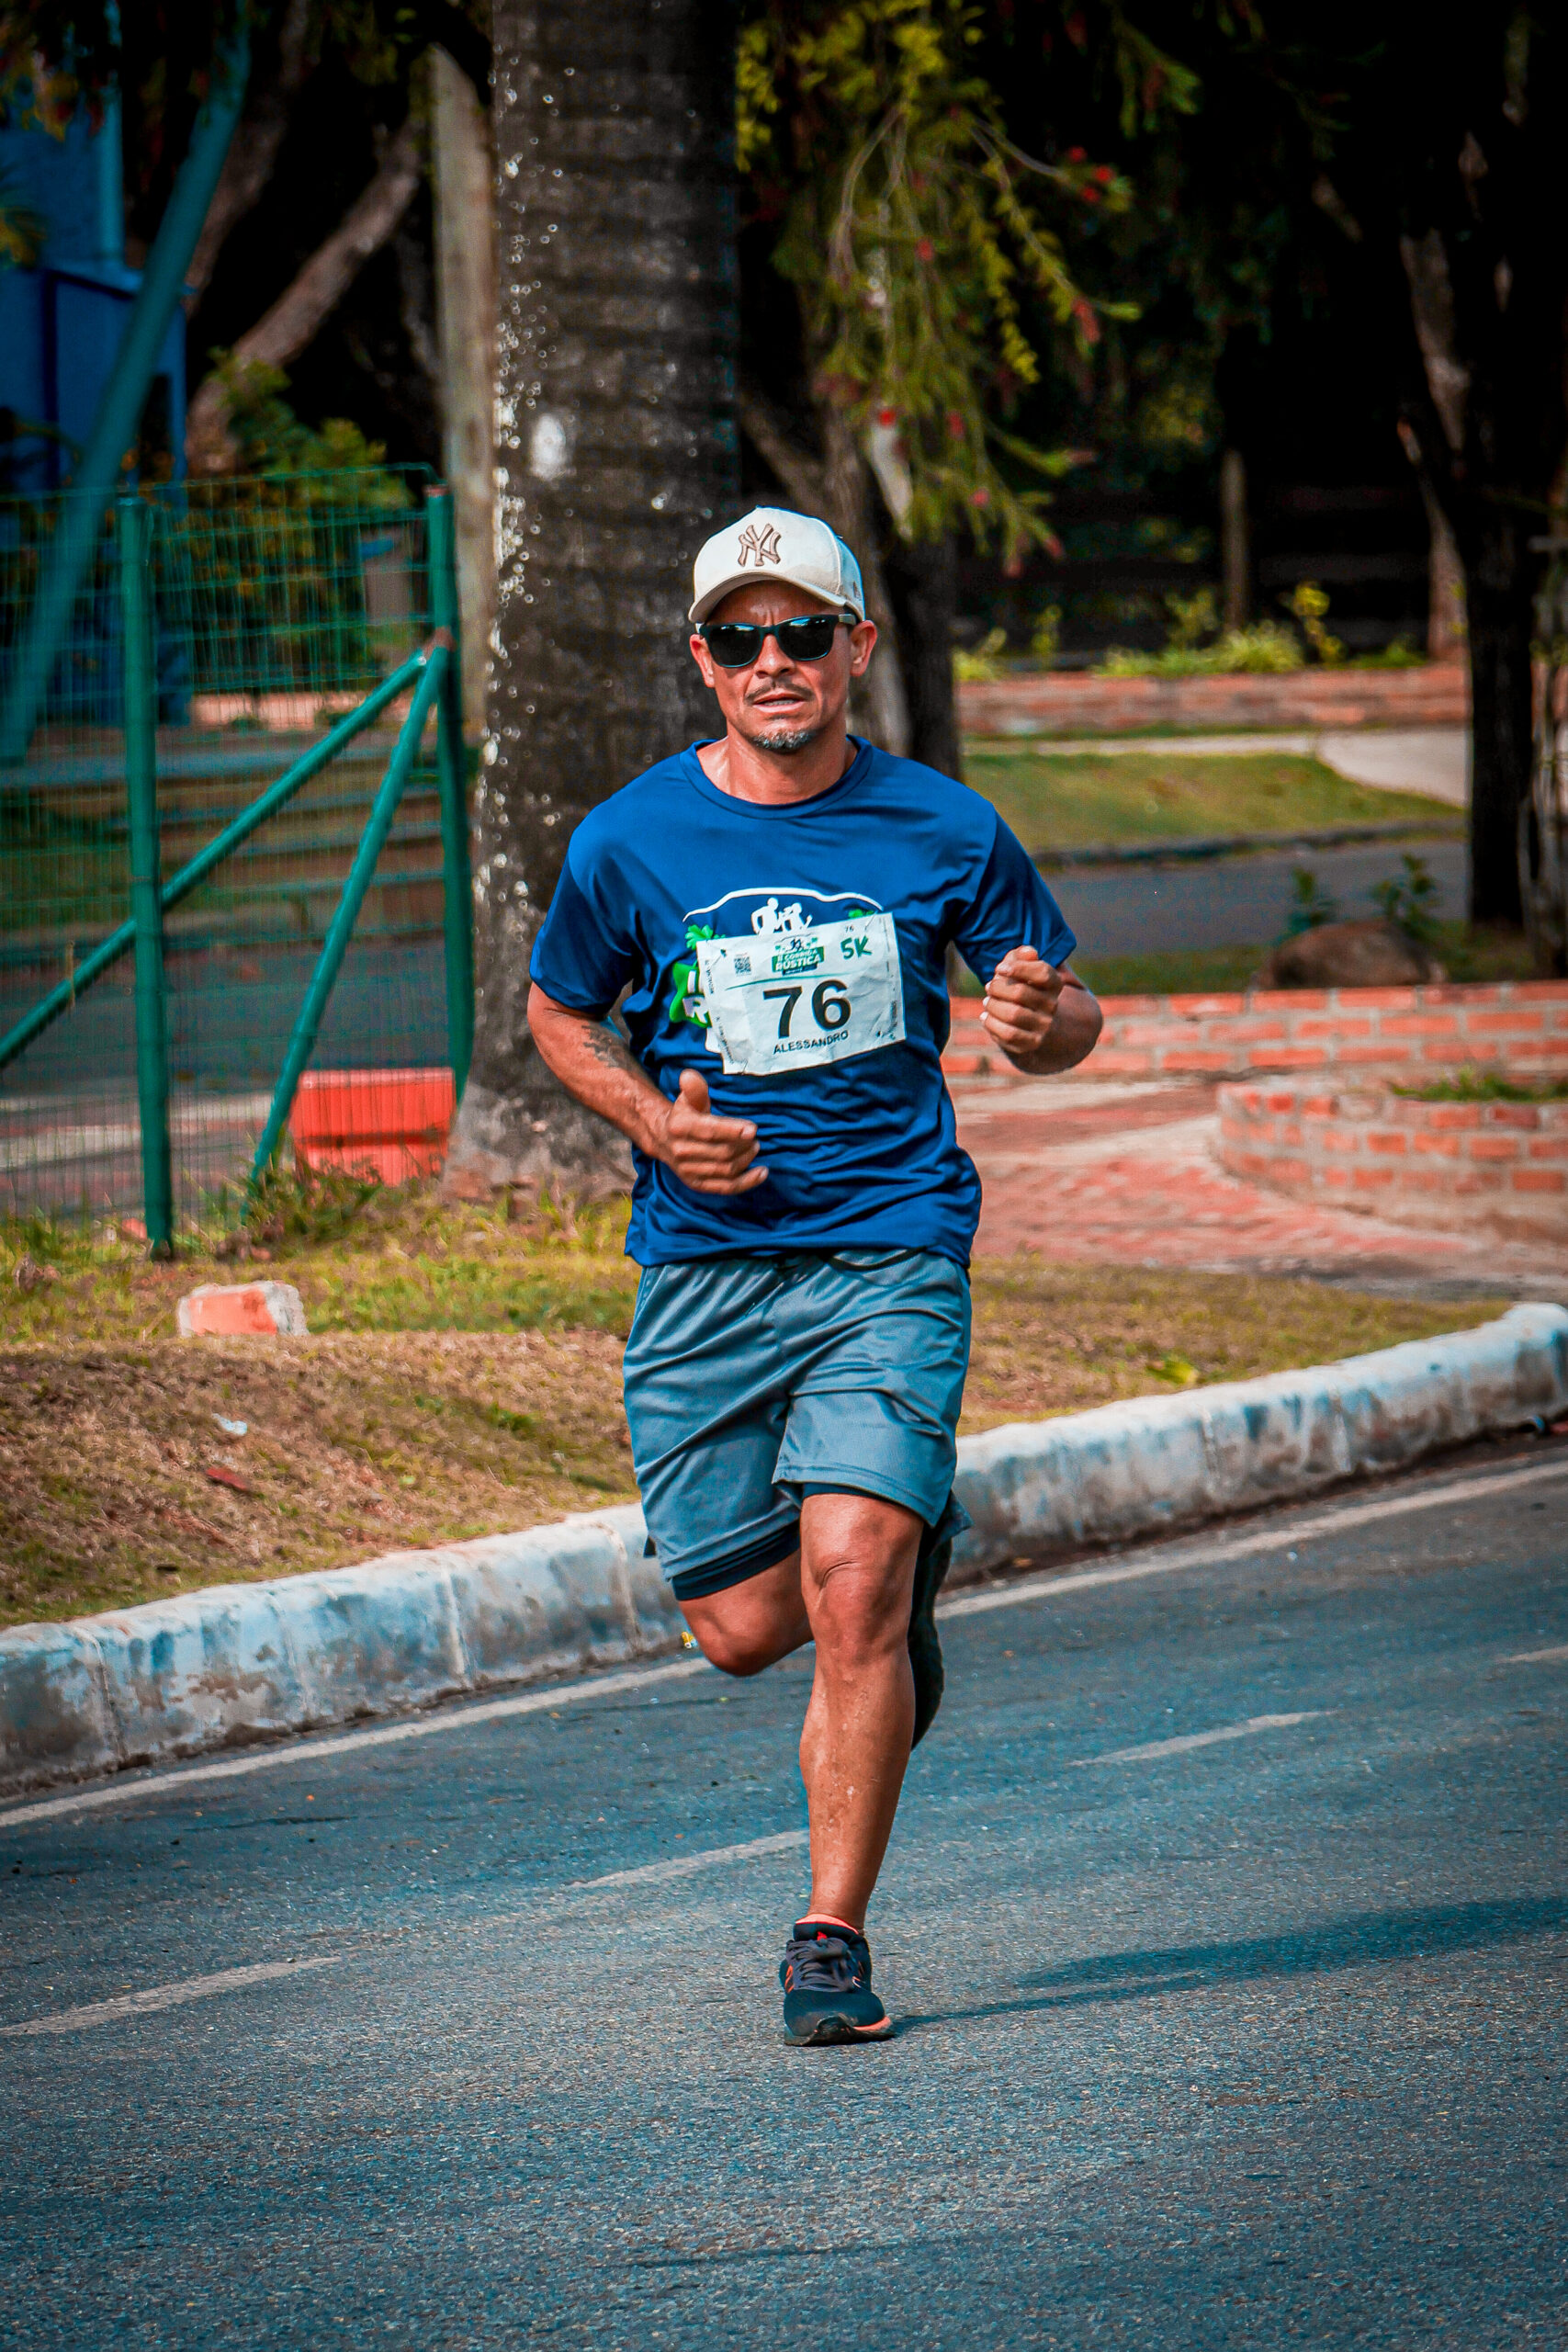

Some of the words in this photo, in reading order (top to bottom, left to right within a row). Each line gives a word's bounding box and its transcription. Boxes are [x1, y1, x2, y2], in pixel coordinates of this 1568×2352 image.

[737, 523, 782, 567] NY
[840, 935, 873, 960] 5K
[762, 979, 852, 1039] 76
[773, 1029, 849, 1055] ALESSANDRO
